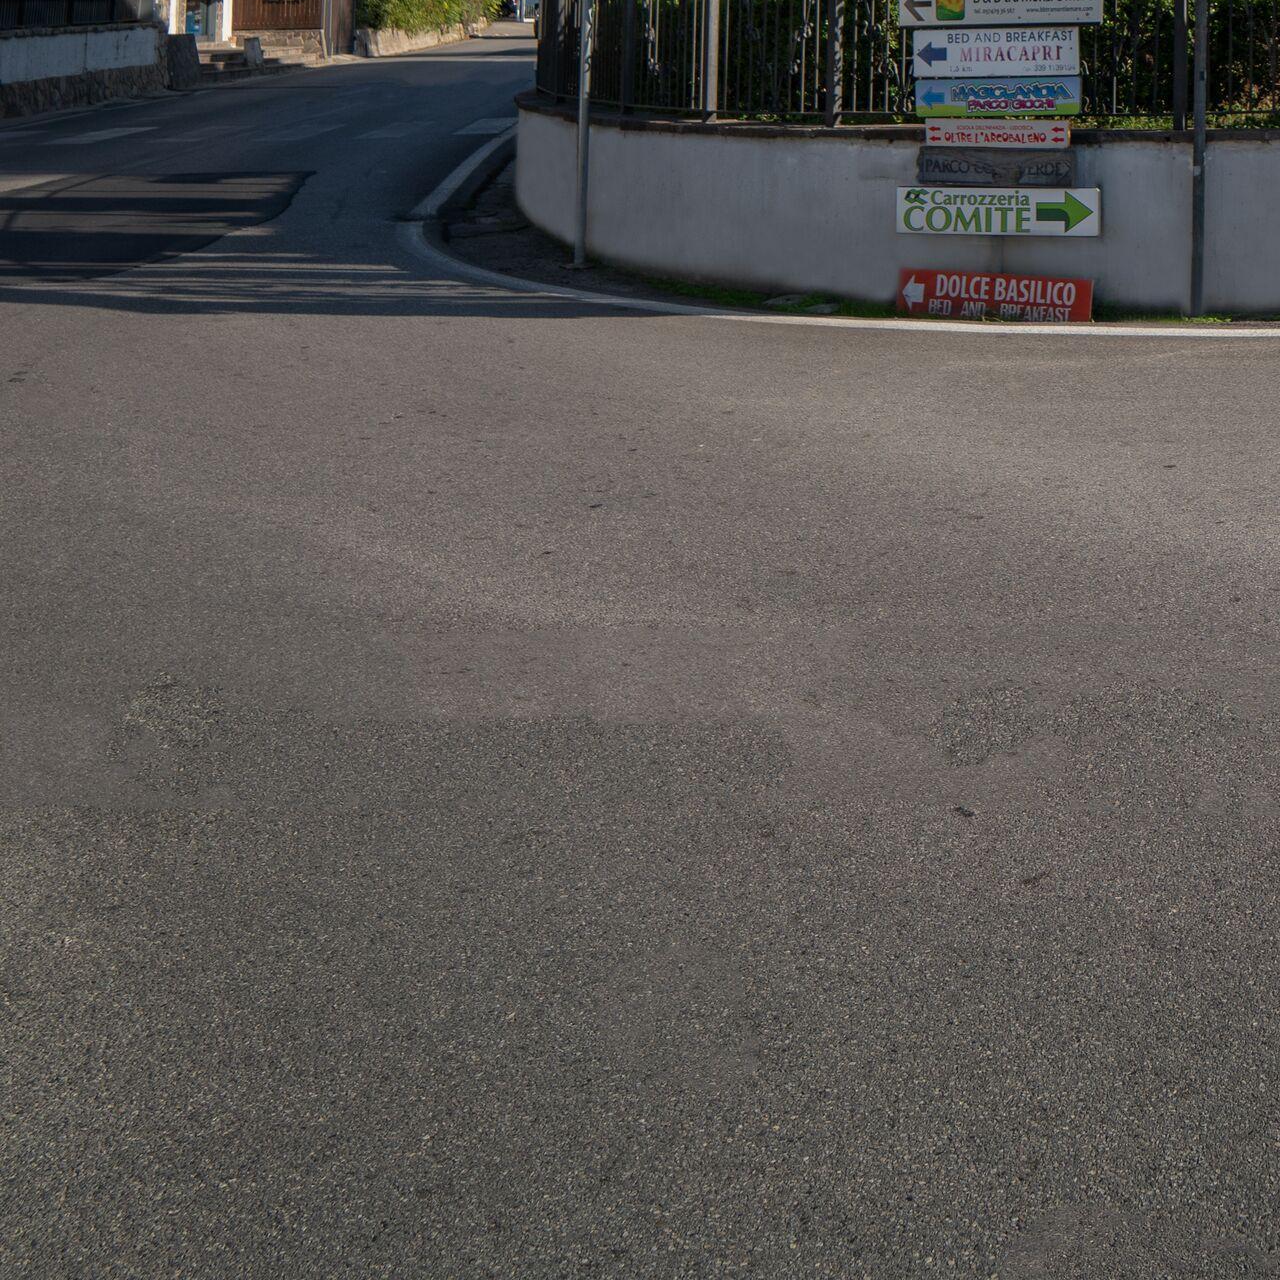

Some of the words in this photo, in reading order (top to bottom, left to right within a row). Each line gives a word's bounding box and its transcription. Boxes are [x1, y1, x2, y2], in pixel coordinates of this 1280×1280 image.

[947, 33, 969, 44] BED
[975, 32, 1001, 43] AND
[1006, 30, 1073, 43] BREAKFAST
[960, 45, 1061, 62] MIRACAPRI
[951, 81, 1074, 101] MAGICLANDIA
[967, 99, 1010, 114] PARCO
[1010, 99, 1056, 112] GIOCHI
[944, 132, 972, 144] OLTRE
[974, 132, 1047, 145] L'ARCOBALENO
[926, 159, 970, 174] PARCO
[930, 190, 1030, 206] Carrozzeria
[903, 205, 1031, 233] COMITE
[936, 274, 991, 300] DOLCE
[994, 278, 1076, 306] BASILICO
[928, 298, 952, 316] BED
[960, 300, 986, 317] AND
[1000, 302, 1072, 322] BREAKFAST
